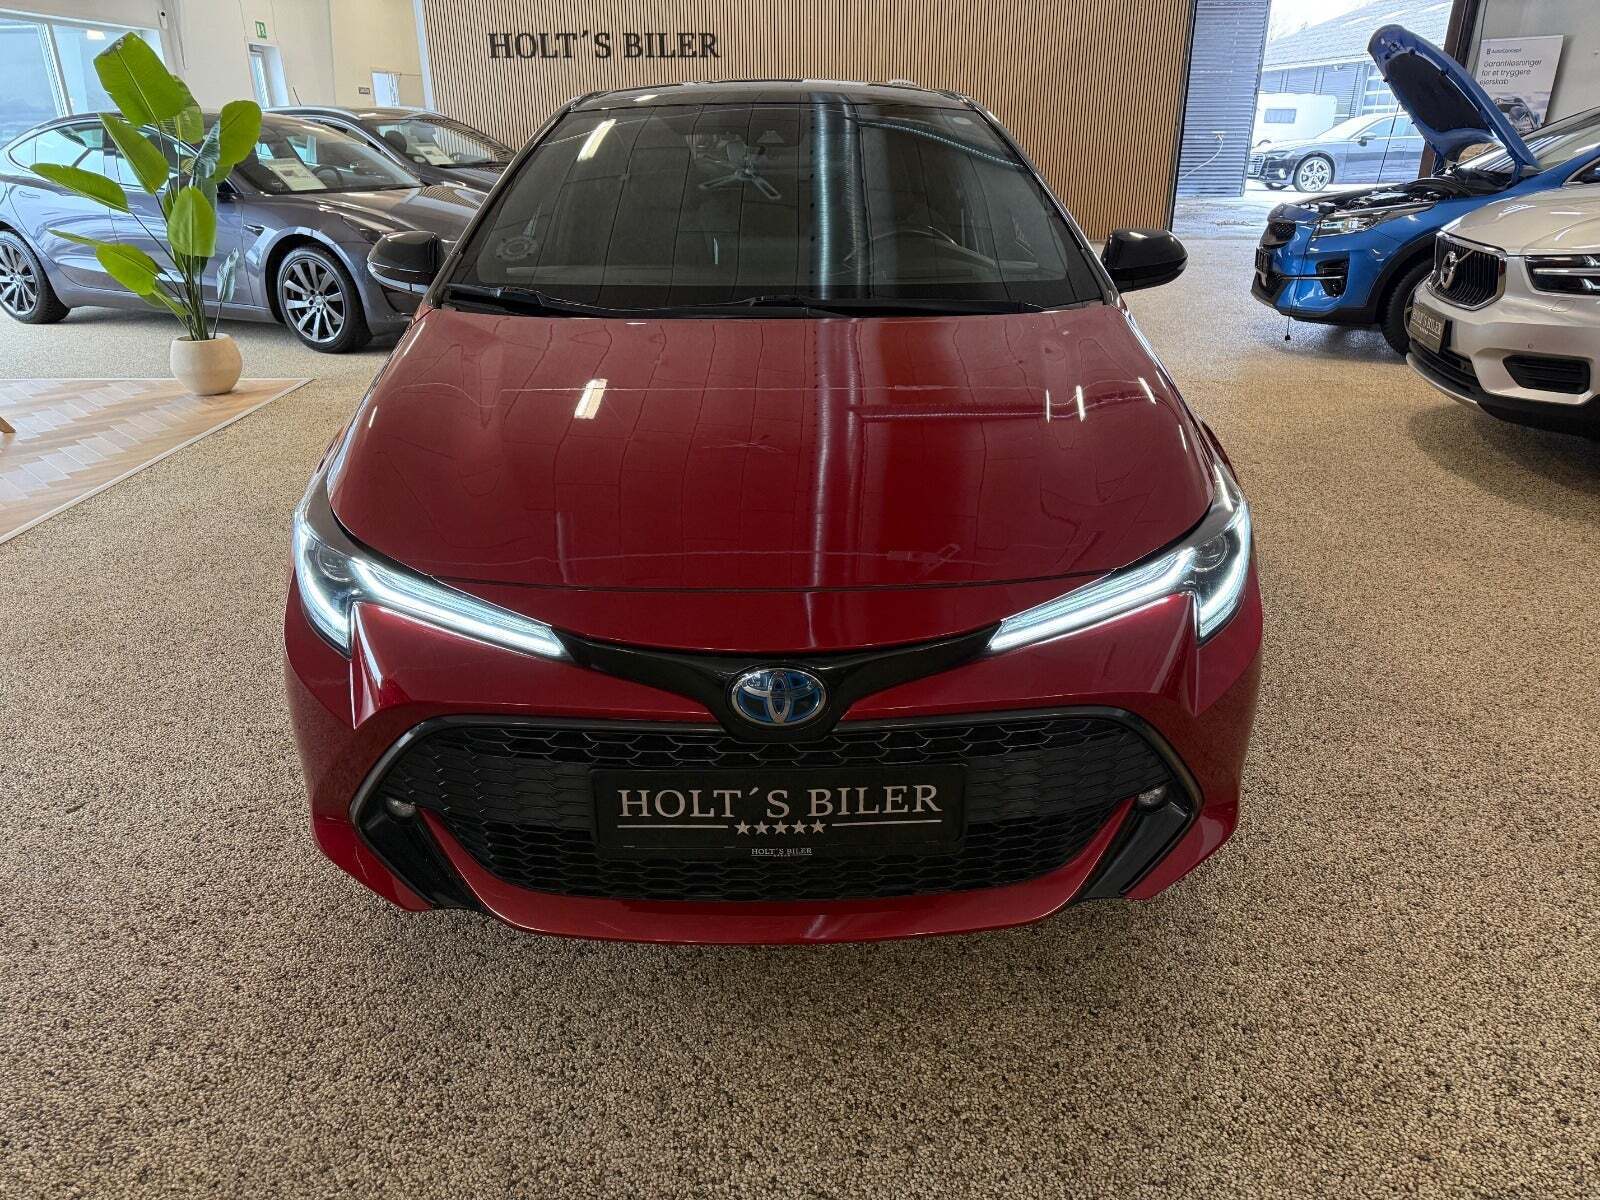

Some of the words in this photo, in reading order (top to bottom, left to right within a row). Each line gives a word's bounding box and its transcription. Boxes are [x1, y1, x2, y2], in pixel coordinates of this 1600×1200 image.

[623, 32, 721, 58] BILER
[1500, 69, 1531, 77] tryggere
[806, 784, 943, 817] BILER
